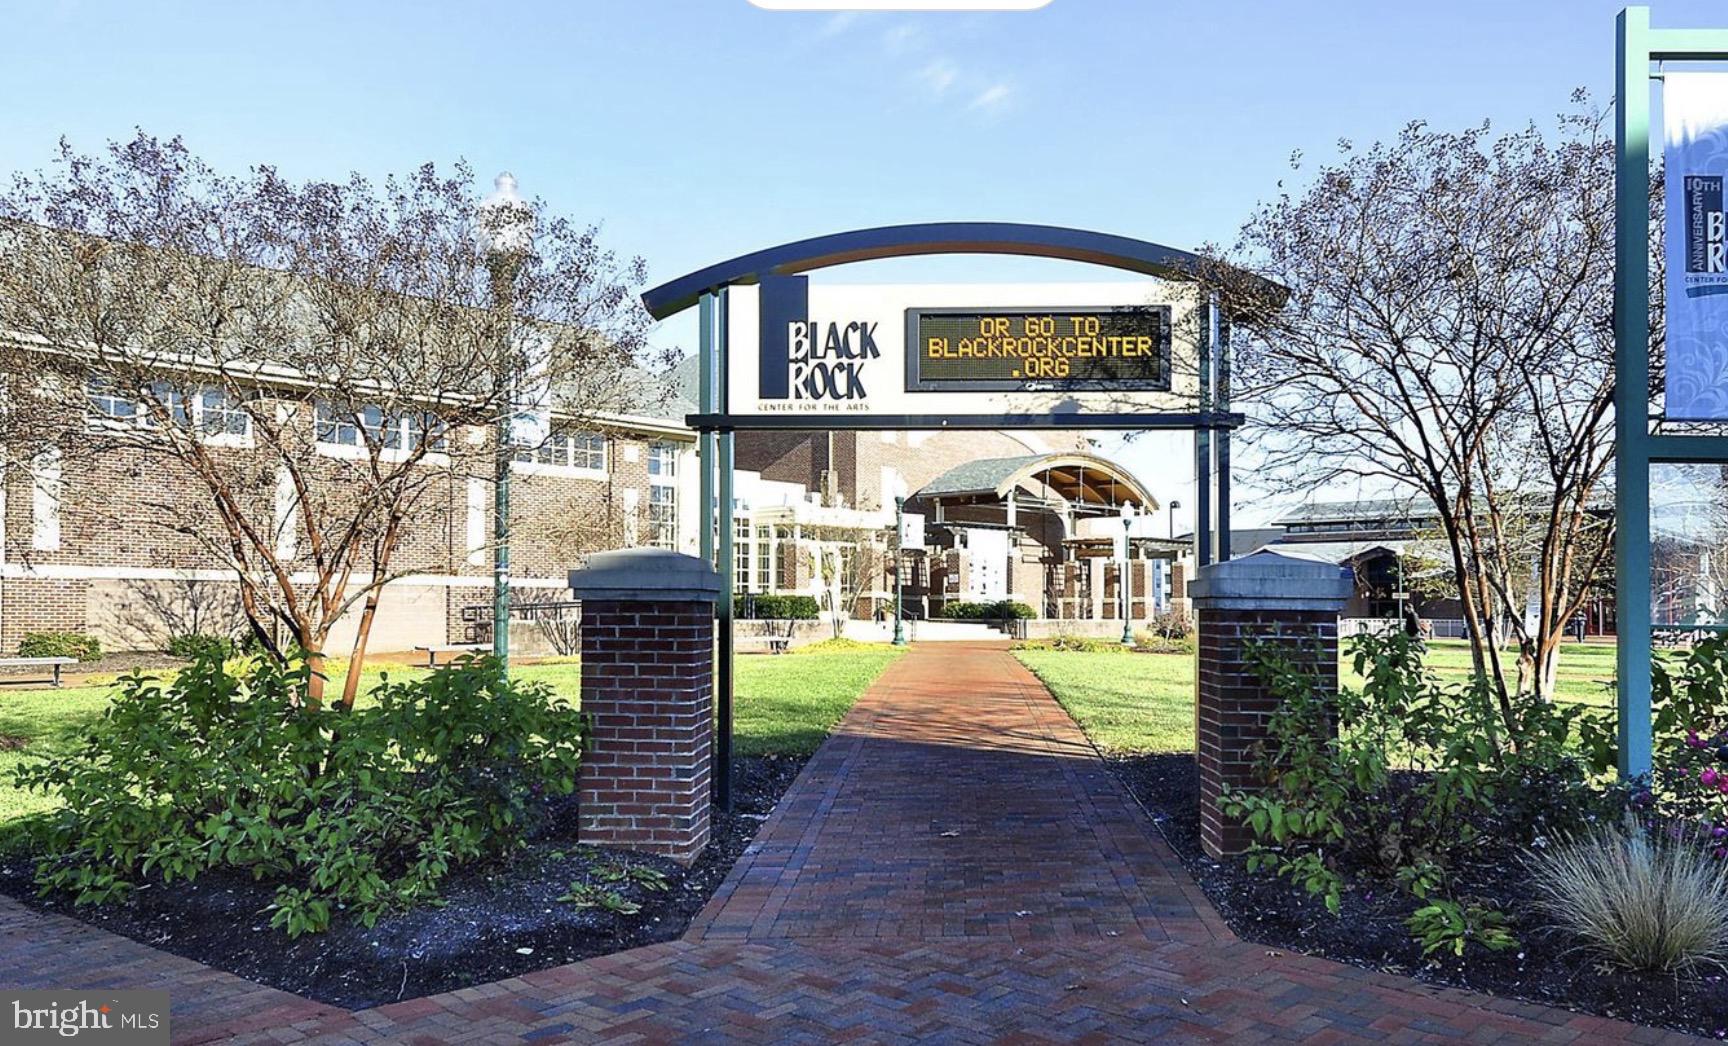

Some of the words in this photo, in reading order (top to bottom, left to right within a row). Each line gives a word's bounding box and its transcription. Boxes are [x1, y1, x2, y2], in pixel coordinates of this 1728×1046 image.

[1687, 177, 1721, 191] 10TH
[1692, 190, 1703, 270] ANNIVERSARY
[1707, 211, 1728, 241] B
[1707, 242, 1728, 273] R
[979, 317, 1010, 337] OR
[1024, 317, 1055, 337] GO
[1070, 317, 1099, 337] TO
[788, 321, 880, 360] BLACK
[928, 337, 1153, 357] BLACKROCKCENTER
[1011, 357, 1070, 378] .ORG
[788, 361, 867, 400] ROCK
[758, 403, 794, 411] CENTER
[799, 403, 817, 411] FOR
[823, 403, 839, 411] THE
[846, 403, 869, 411] ARTS
